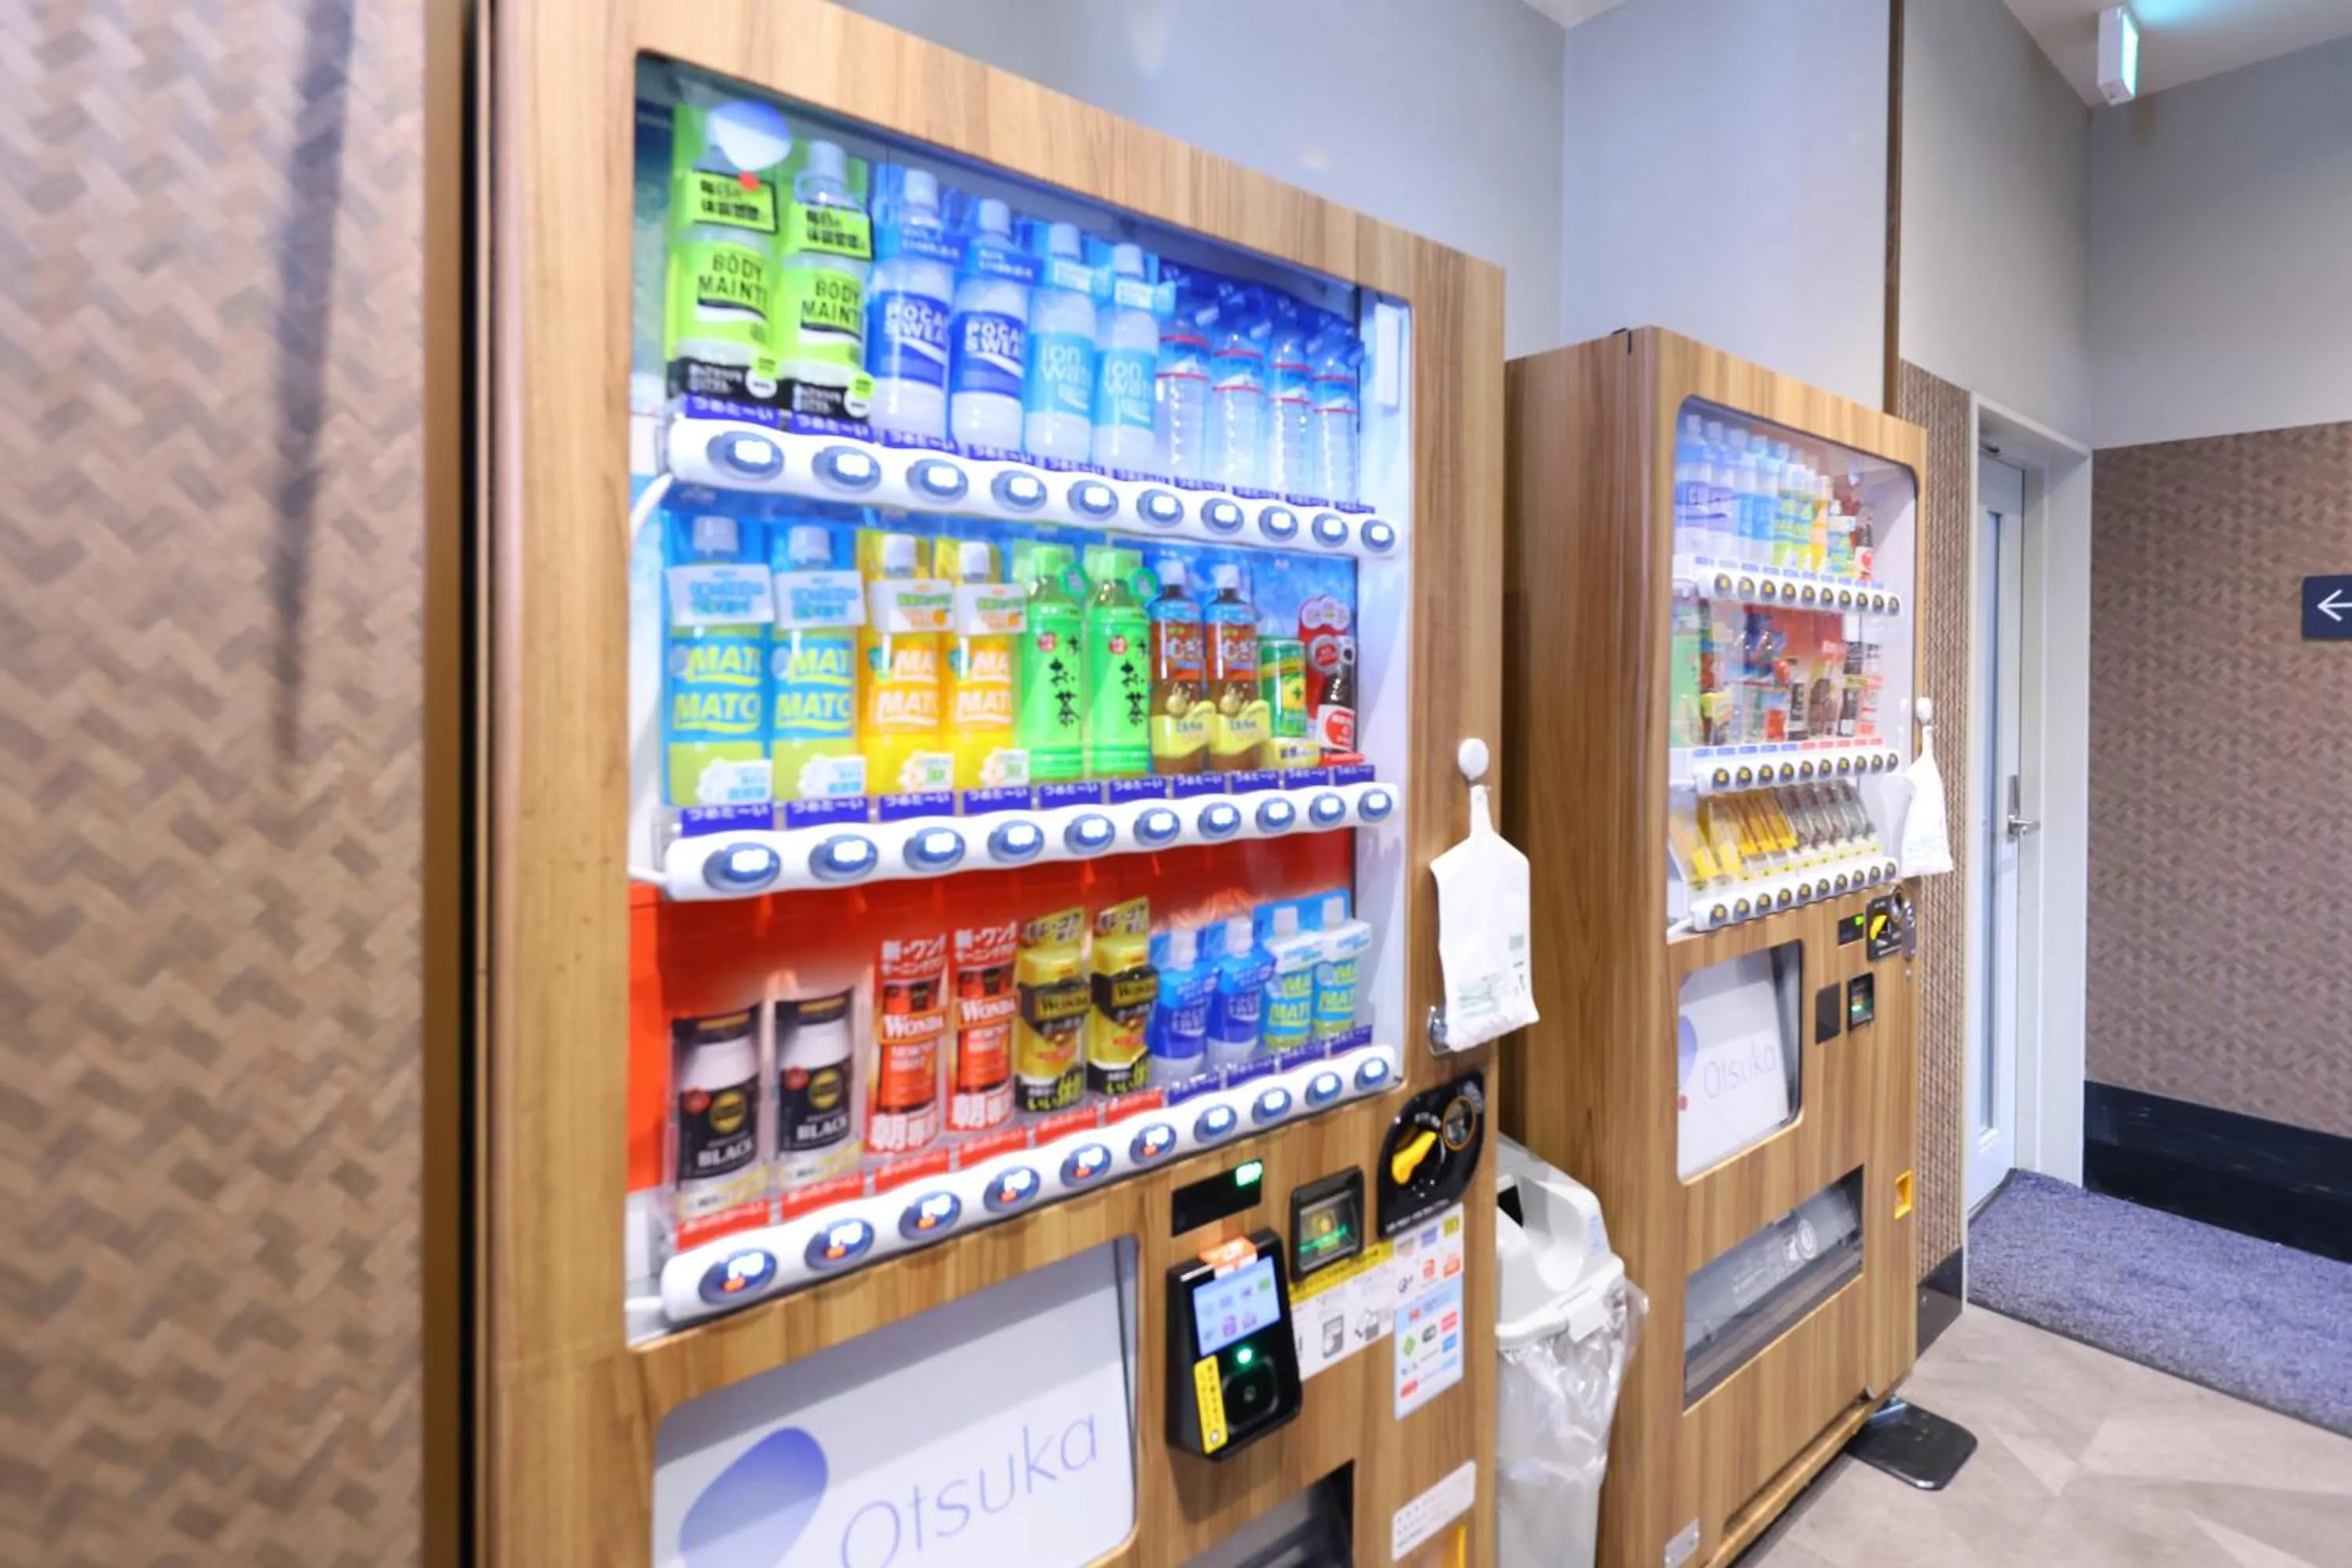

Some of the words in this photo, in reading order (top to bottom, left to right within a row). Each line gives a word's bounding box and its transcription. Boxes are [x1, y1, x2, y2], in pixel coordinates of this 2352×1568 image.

[713, 254, 762, 281] BODY
[815, 280, 860, 303] BODY
[1703, 1040, 1777, 1099] Otsuka
[797, 1116, 848, 1141] BLACK
[697, 1138, 753, 1168] BLACK
[841, 1414, 1097, 1568] Otsuka
